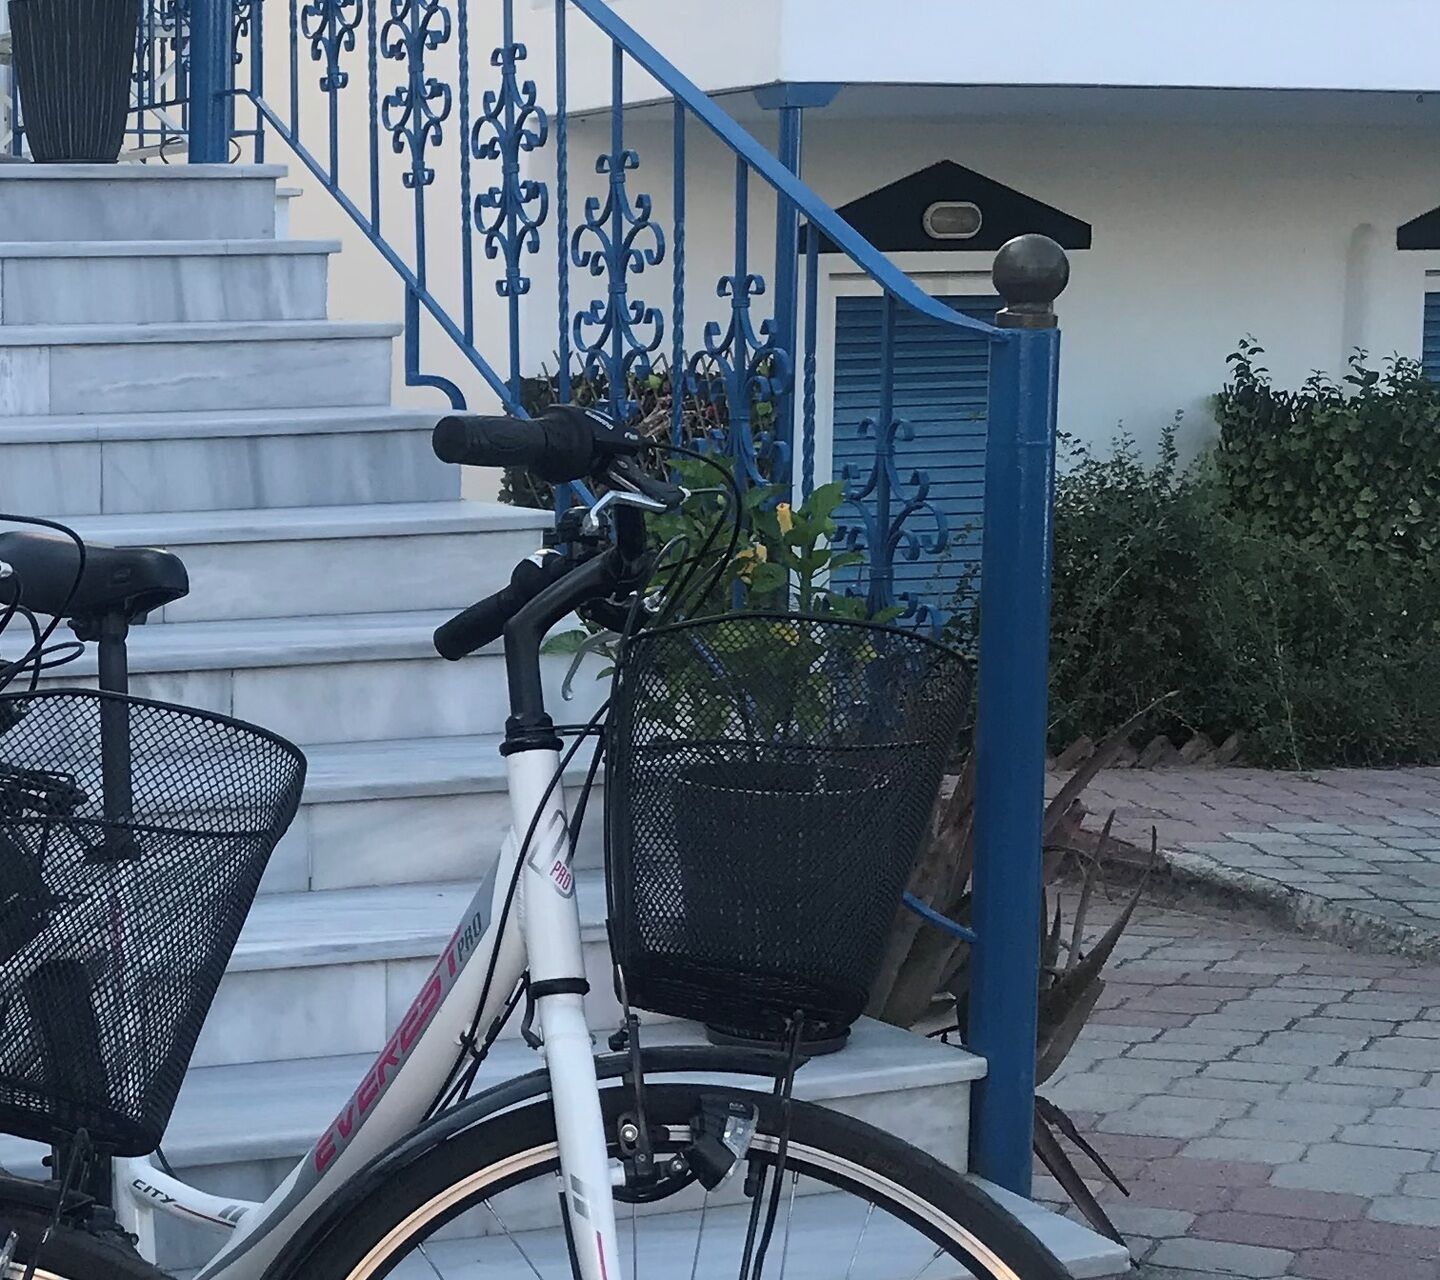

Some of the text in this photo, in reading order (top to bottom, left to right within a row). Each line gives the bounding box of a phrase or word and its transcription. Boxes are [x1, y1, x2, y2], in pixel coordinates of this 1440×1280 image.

[549, 859, 572, 891] PRO
[314, 911, 482, 1172] EVEREST PRO
[132, 1179, 177, 1203] CITY
